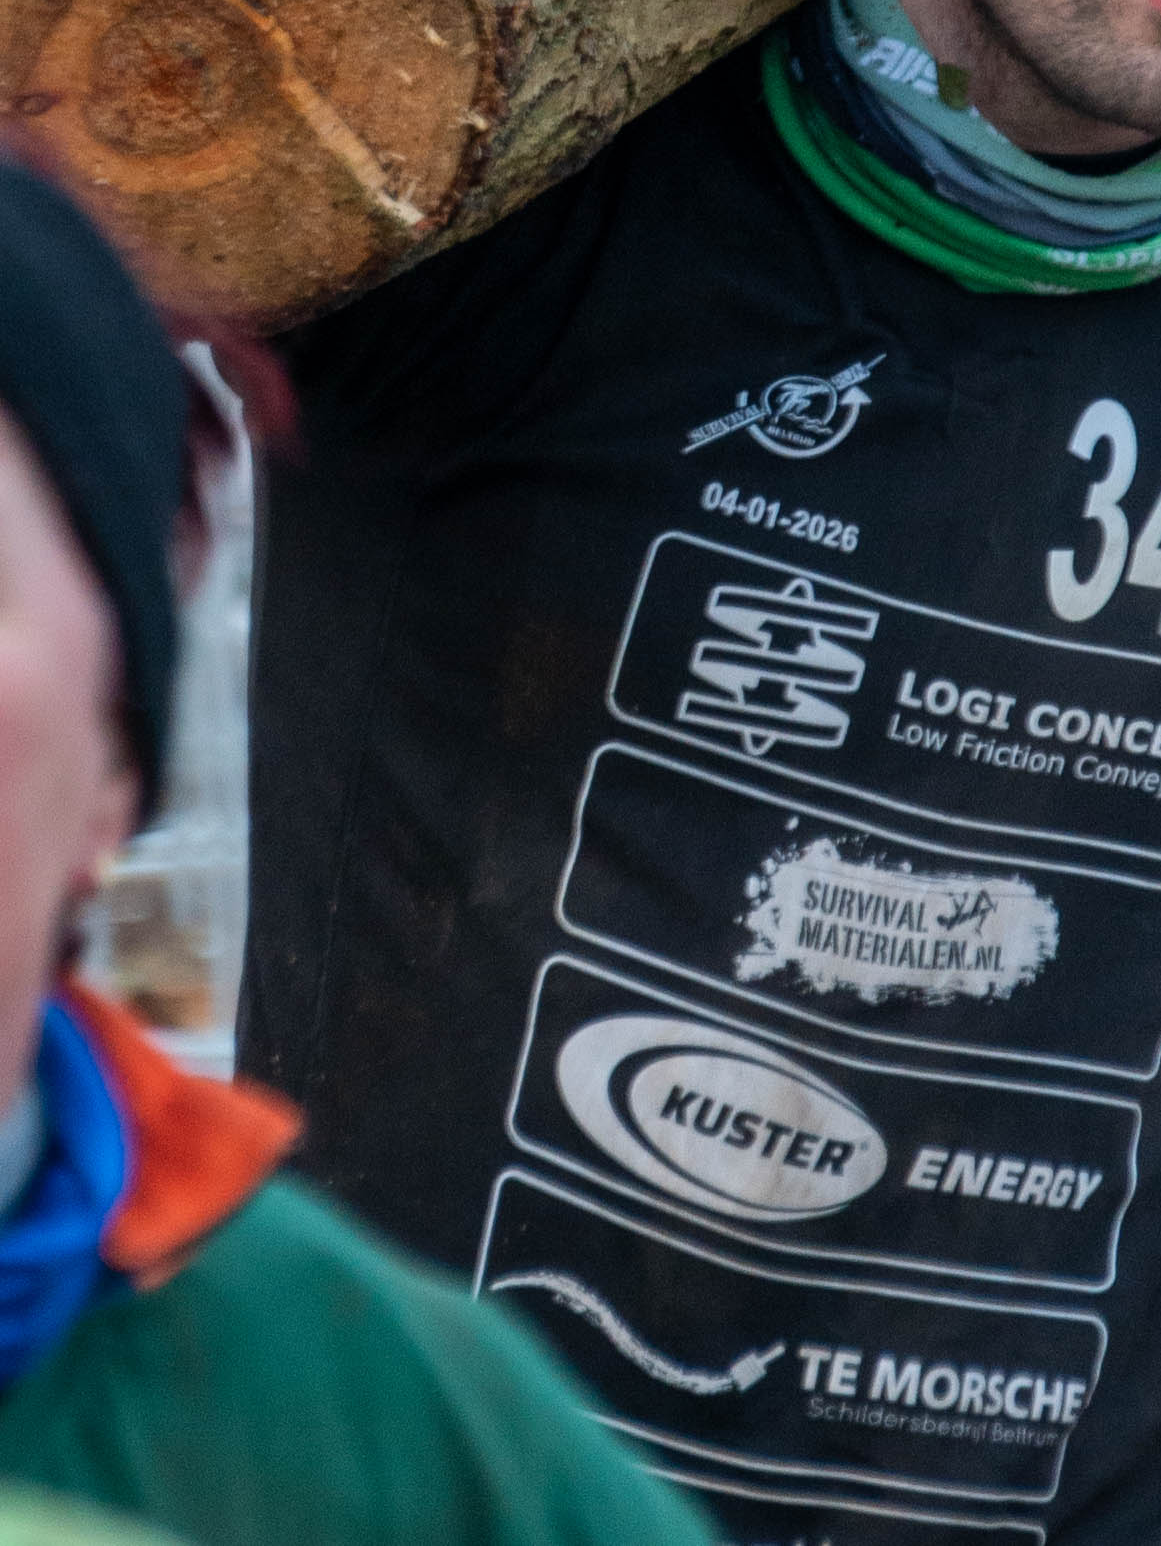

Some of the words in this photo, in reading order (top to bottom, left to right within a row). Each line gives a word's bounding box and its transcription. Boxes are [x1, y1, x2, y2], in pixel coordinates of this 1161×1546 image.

[701, 481, 860, 553] 04-01-2026
[896, 669, 1017, 731] LOGI
[886, 712, 948, 753] Low
[953, 732, 1066, 777] Friction
[804, 879, 929, 933] SURVIVAL
[797, 916, 1004, 973] MATERIALEN.NL
[660, 1085, 856, 1177] KUSTER
[905, 1148, 1104, 1212] ENERGY
[799, 1346, 862, 1396] TE
[868, 1356, 1087, 1425] MORSCHE
